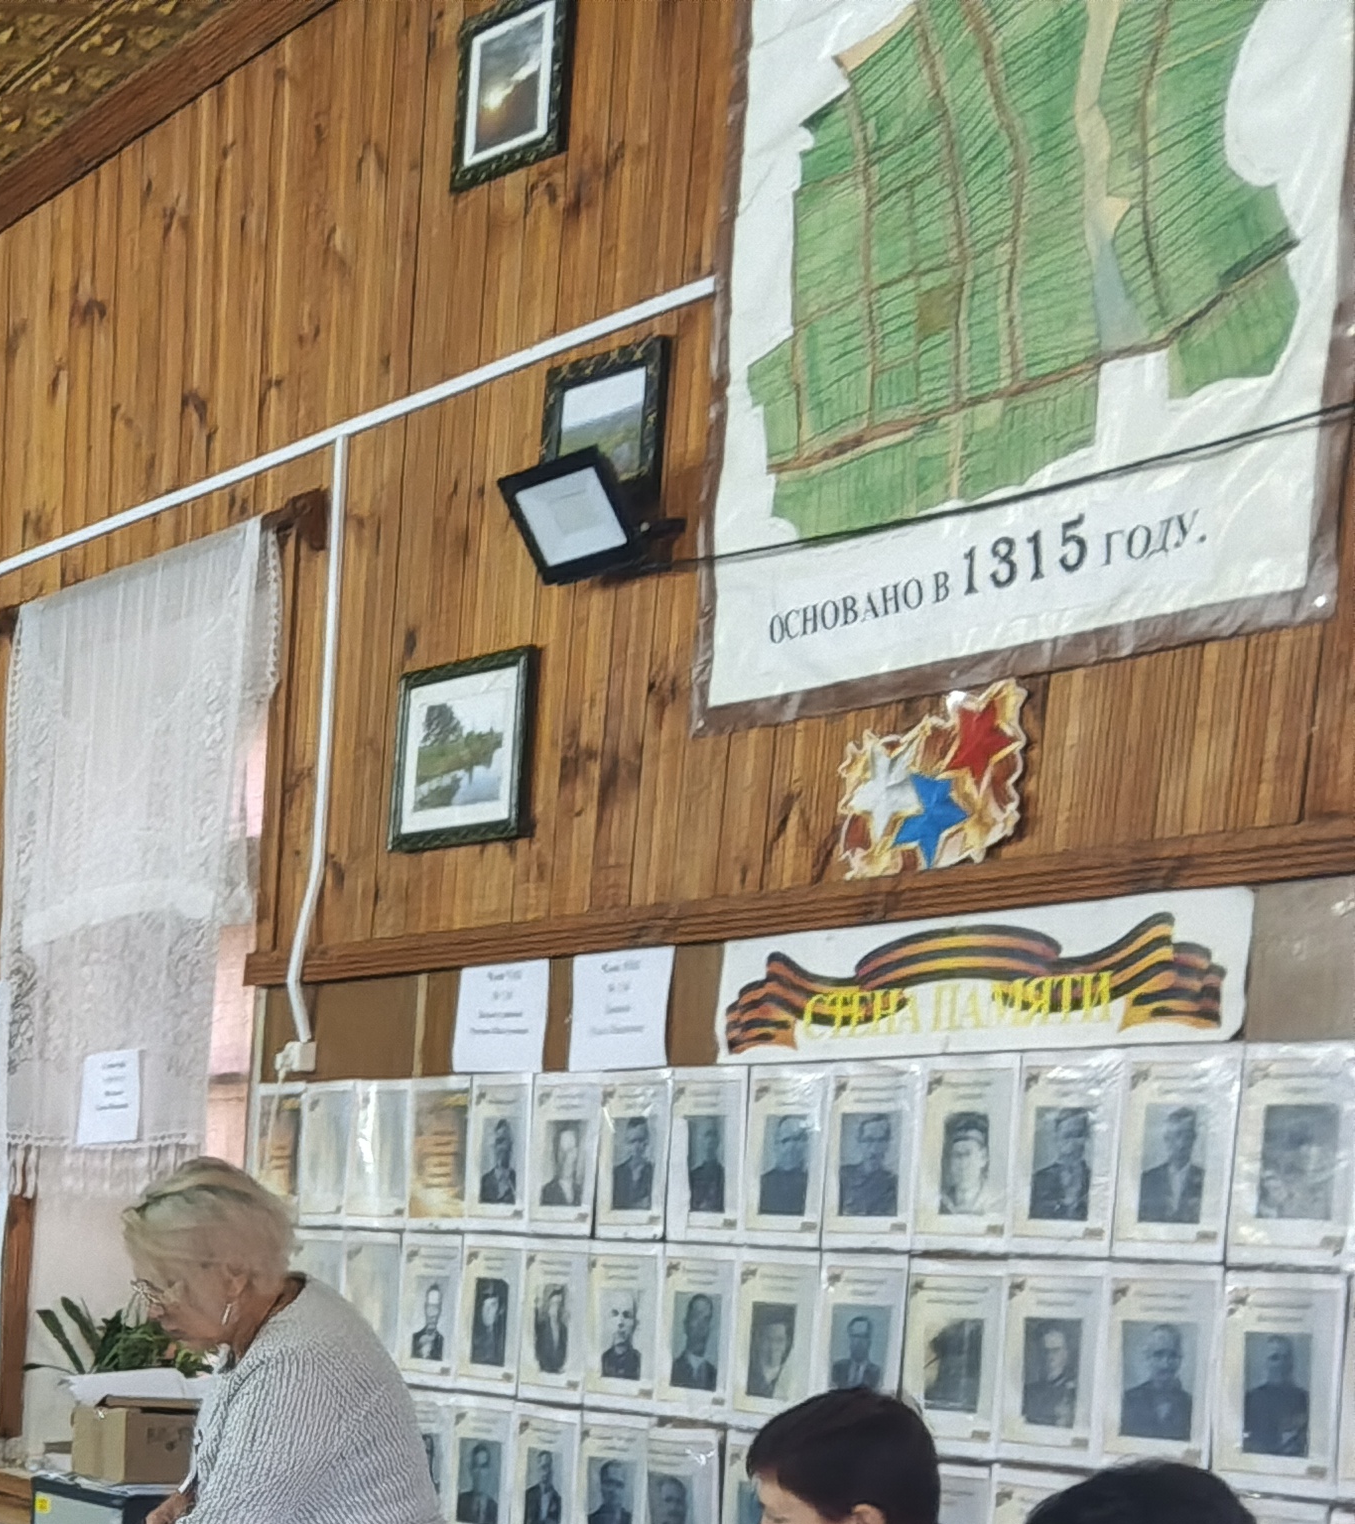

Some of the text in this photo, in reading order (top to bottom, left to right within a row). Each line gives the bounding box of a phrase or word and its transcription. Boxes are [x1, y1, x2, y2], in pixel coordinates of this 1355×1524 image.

[768, 508, 1208, 645] ОСНОВАНО В 1315 ГОДУ.
[802, 970, 1115, 1040] СТЕНА ПАМЯТИ
